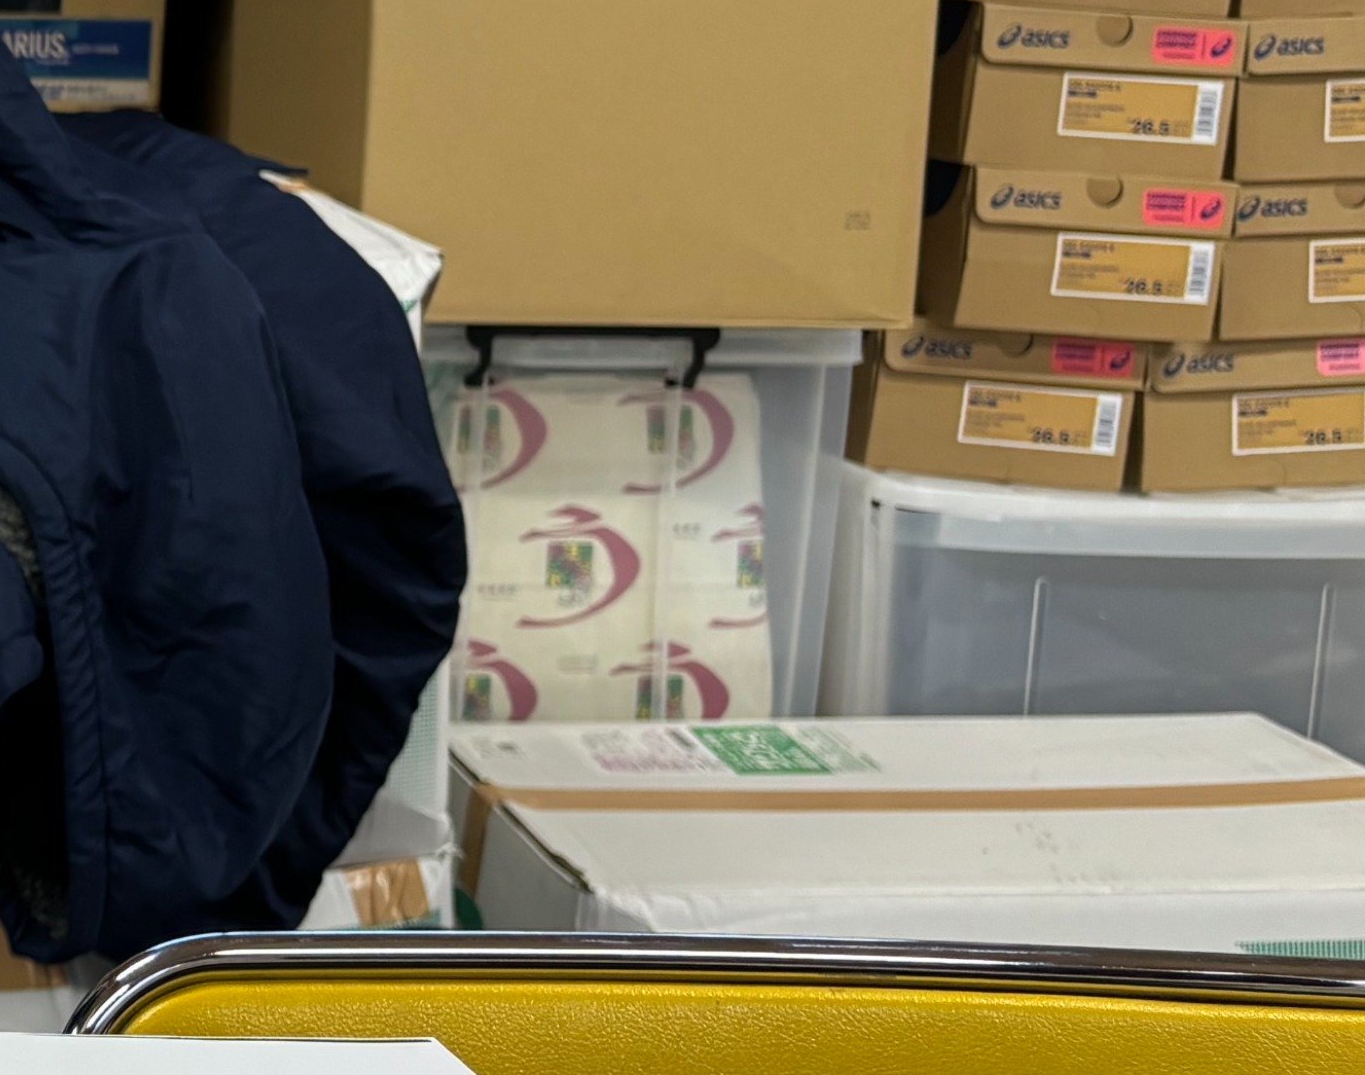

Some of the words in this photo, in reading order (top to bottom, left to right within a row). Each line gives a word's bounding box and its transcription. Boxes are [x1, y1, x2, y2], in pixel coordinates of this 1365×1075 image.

[1, 31, 67, 60] ARIUS
[1020, 30, 1070, 50] asics
[1277, 36, 1325, 56] asics
[1013, 191, 1061, 211] asics
[1260, 198, 1307, 218] asics
[1187, 353, 1234, 375] asics
